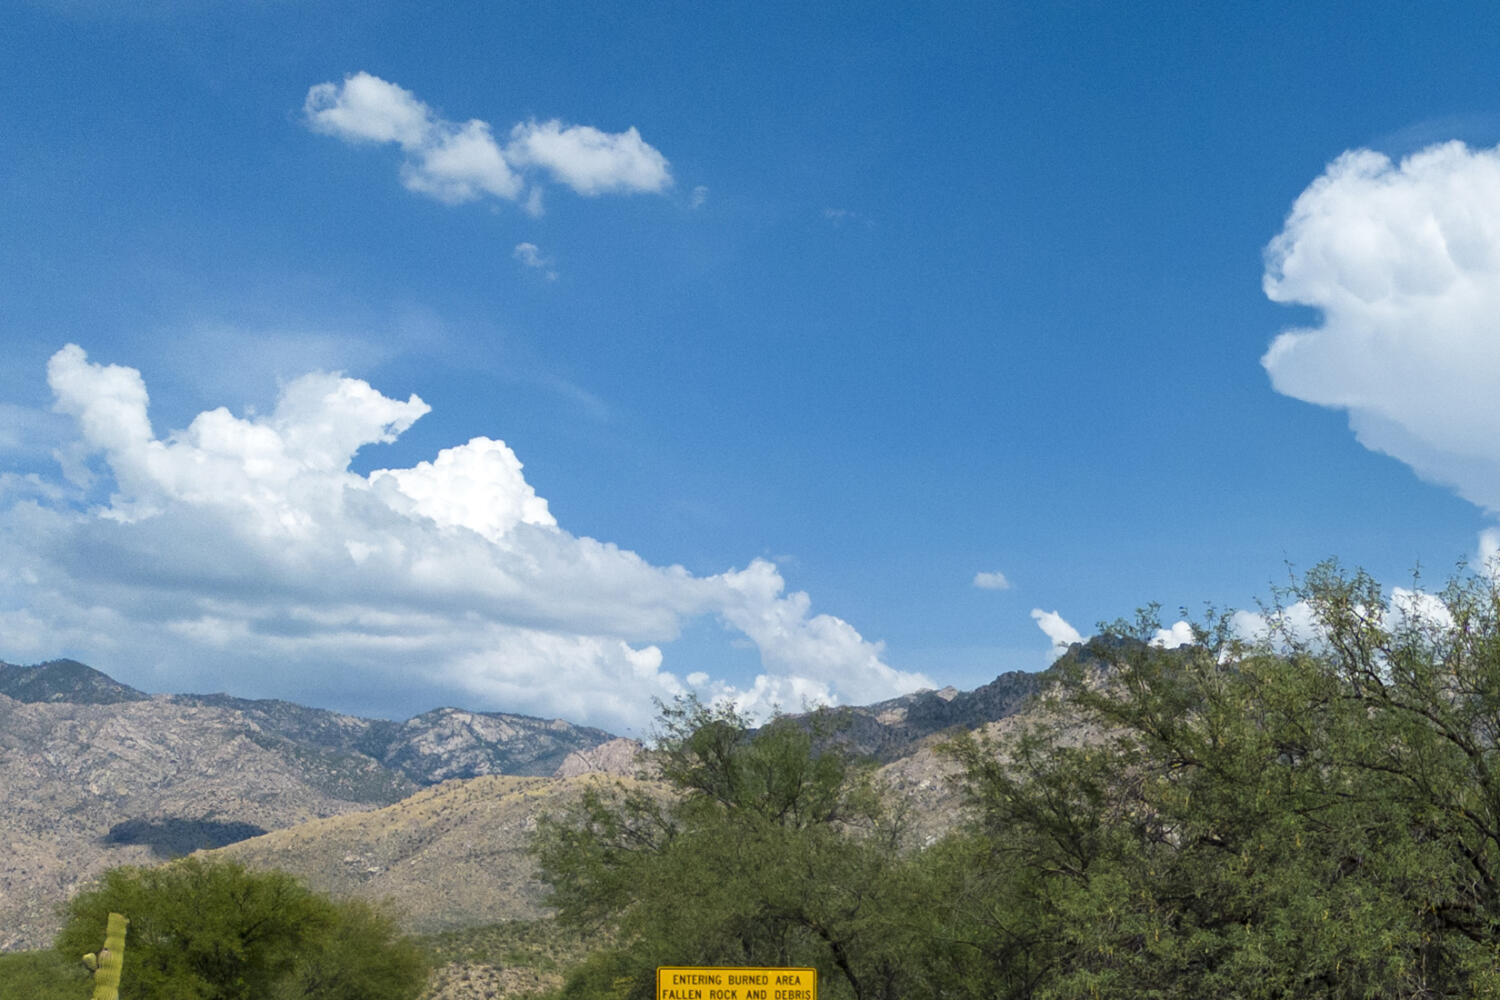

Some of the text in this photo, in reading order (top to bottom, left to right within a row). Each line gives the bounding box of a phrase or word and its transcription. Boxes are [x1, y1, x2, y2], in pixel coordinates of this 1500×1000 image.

[673, 975, 801, 985] ENTERING BURNED AREA
[662, 990, 811, 1000] FALLEN ROCK AND DEBRIS
